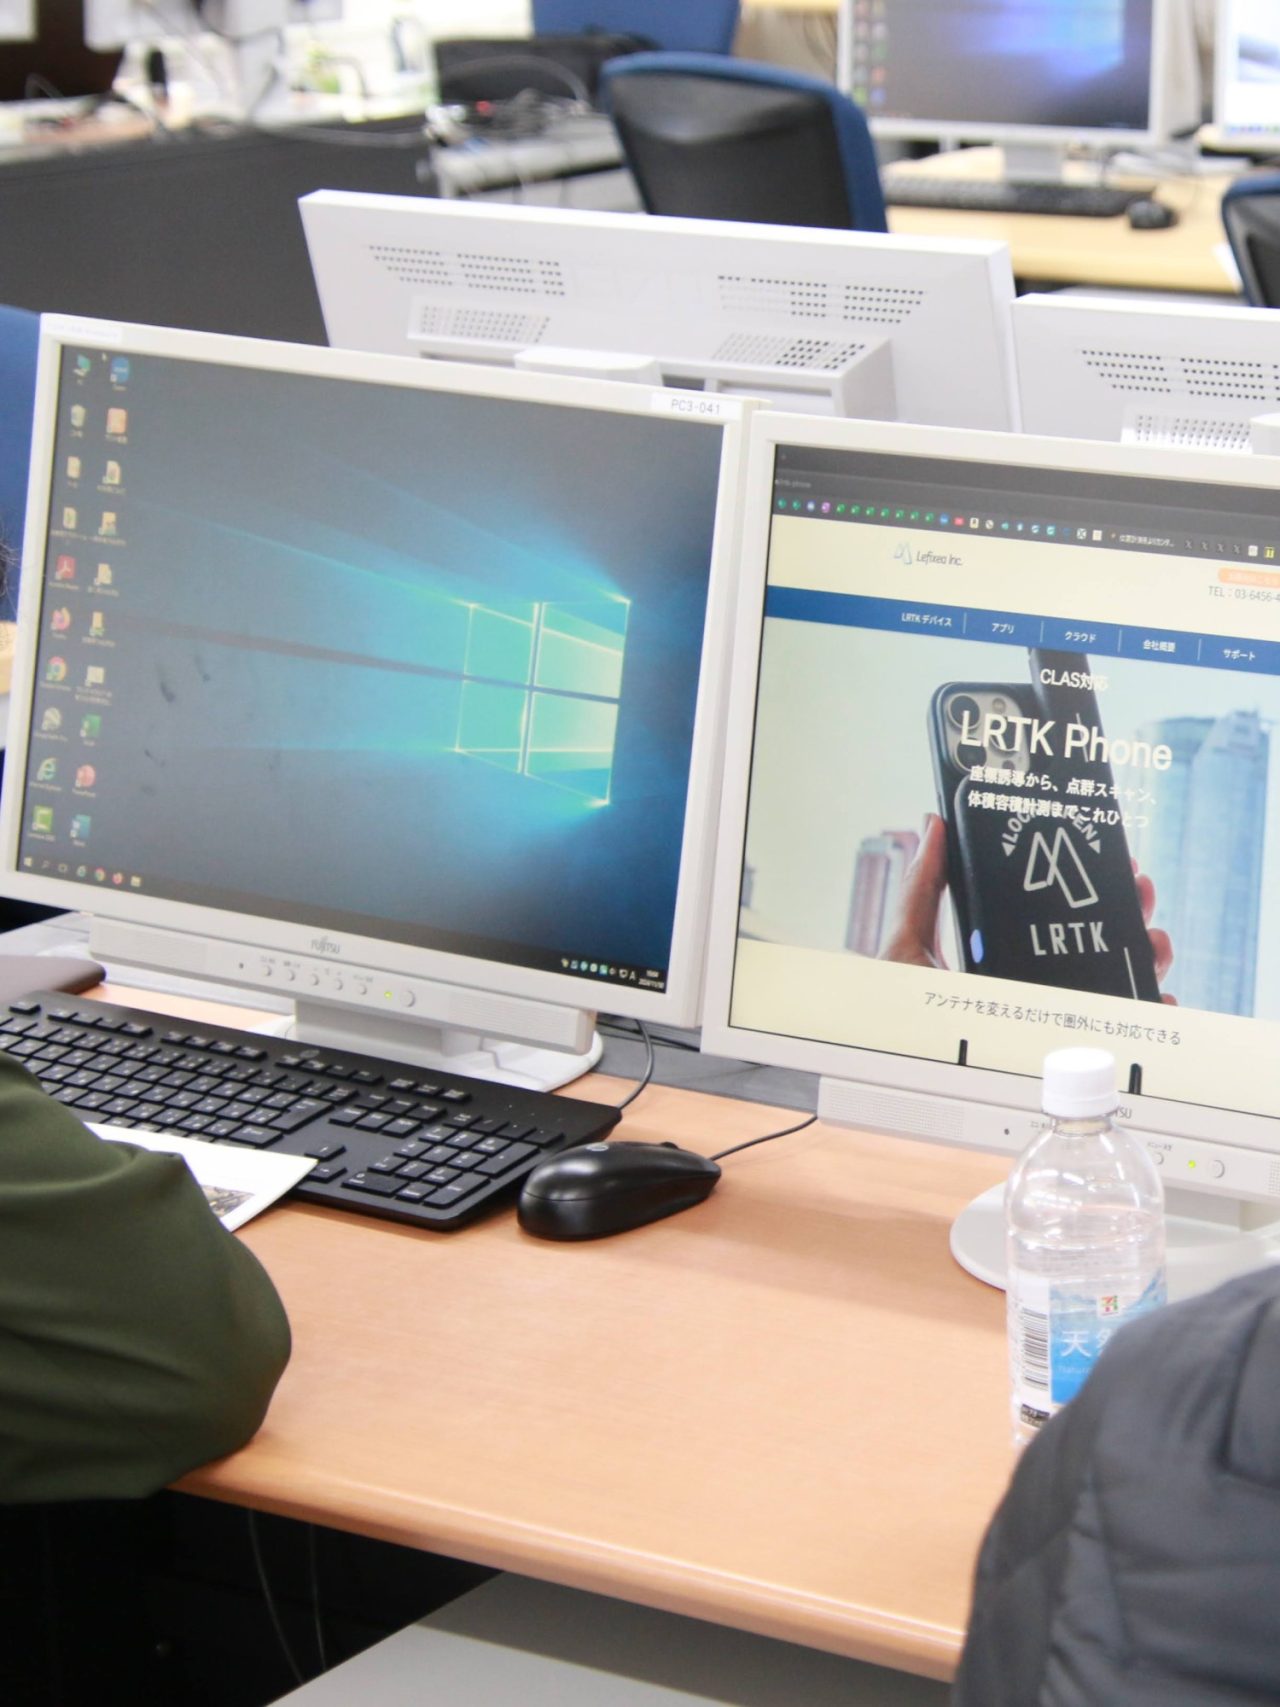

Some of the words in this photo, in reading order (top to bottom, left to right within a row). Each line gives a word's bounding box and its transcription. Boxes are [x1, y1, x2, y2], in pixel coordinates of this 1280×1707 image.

[671, 398, 721, 416] PC3-041
[991, 622, 1015, 635] アプリ
[1064, 630, 1097, 644] クラウド
[1142, 638, 1176, 654] 会社概要
[1223, 648, 1256, 662] サポート
[959, 709, 1056, 757] LRTK
[1064, 722, 1173, 771] Phone
[1029, 920, 1109, 957] LRTK
[924, 991, 1182, 1046] アンテナを変えるだけで圏外にも対応できる
